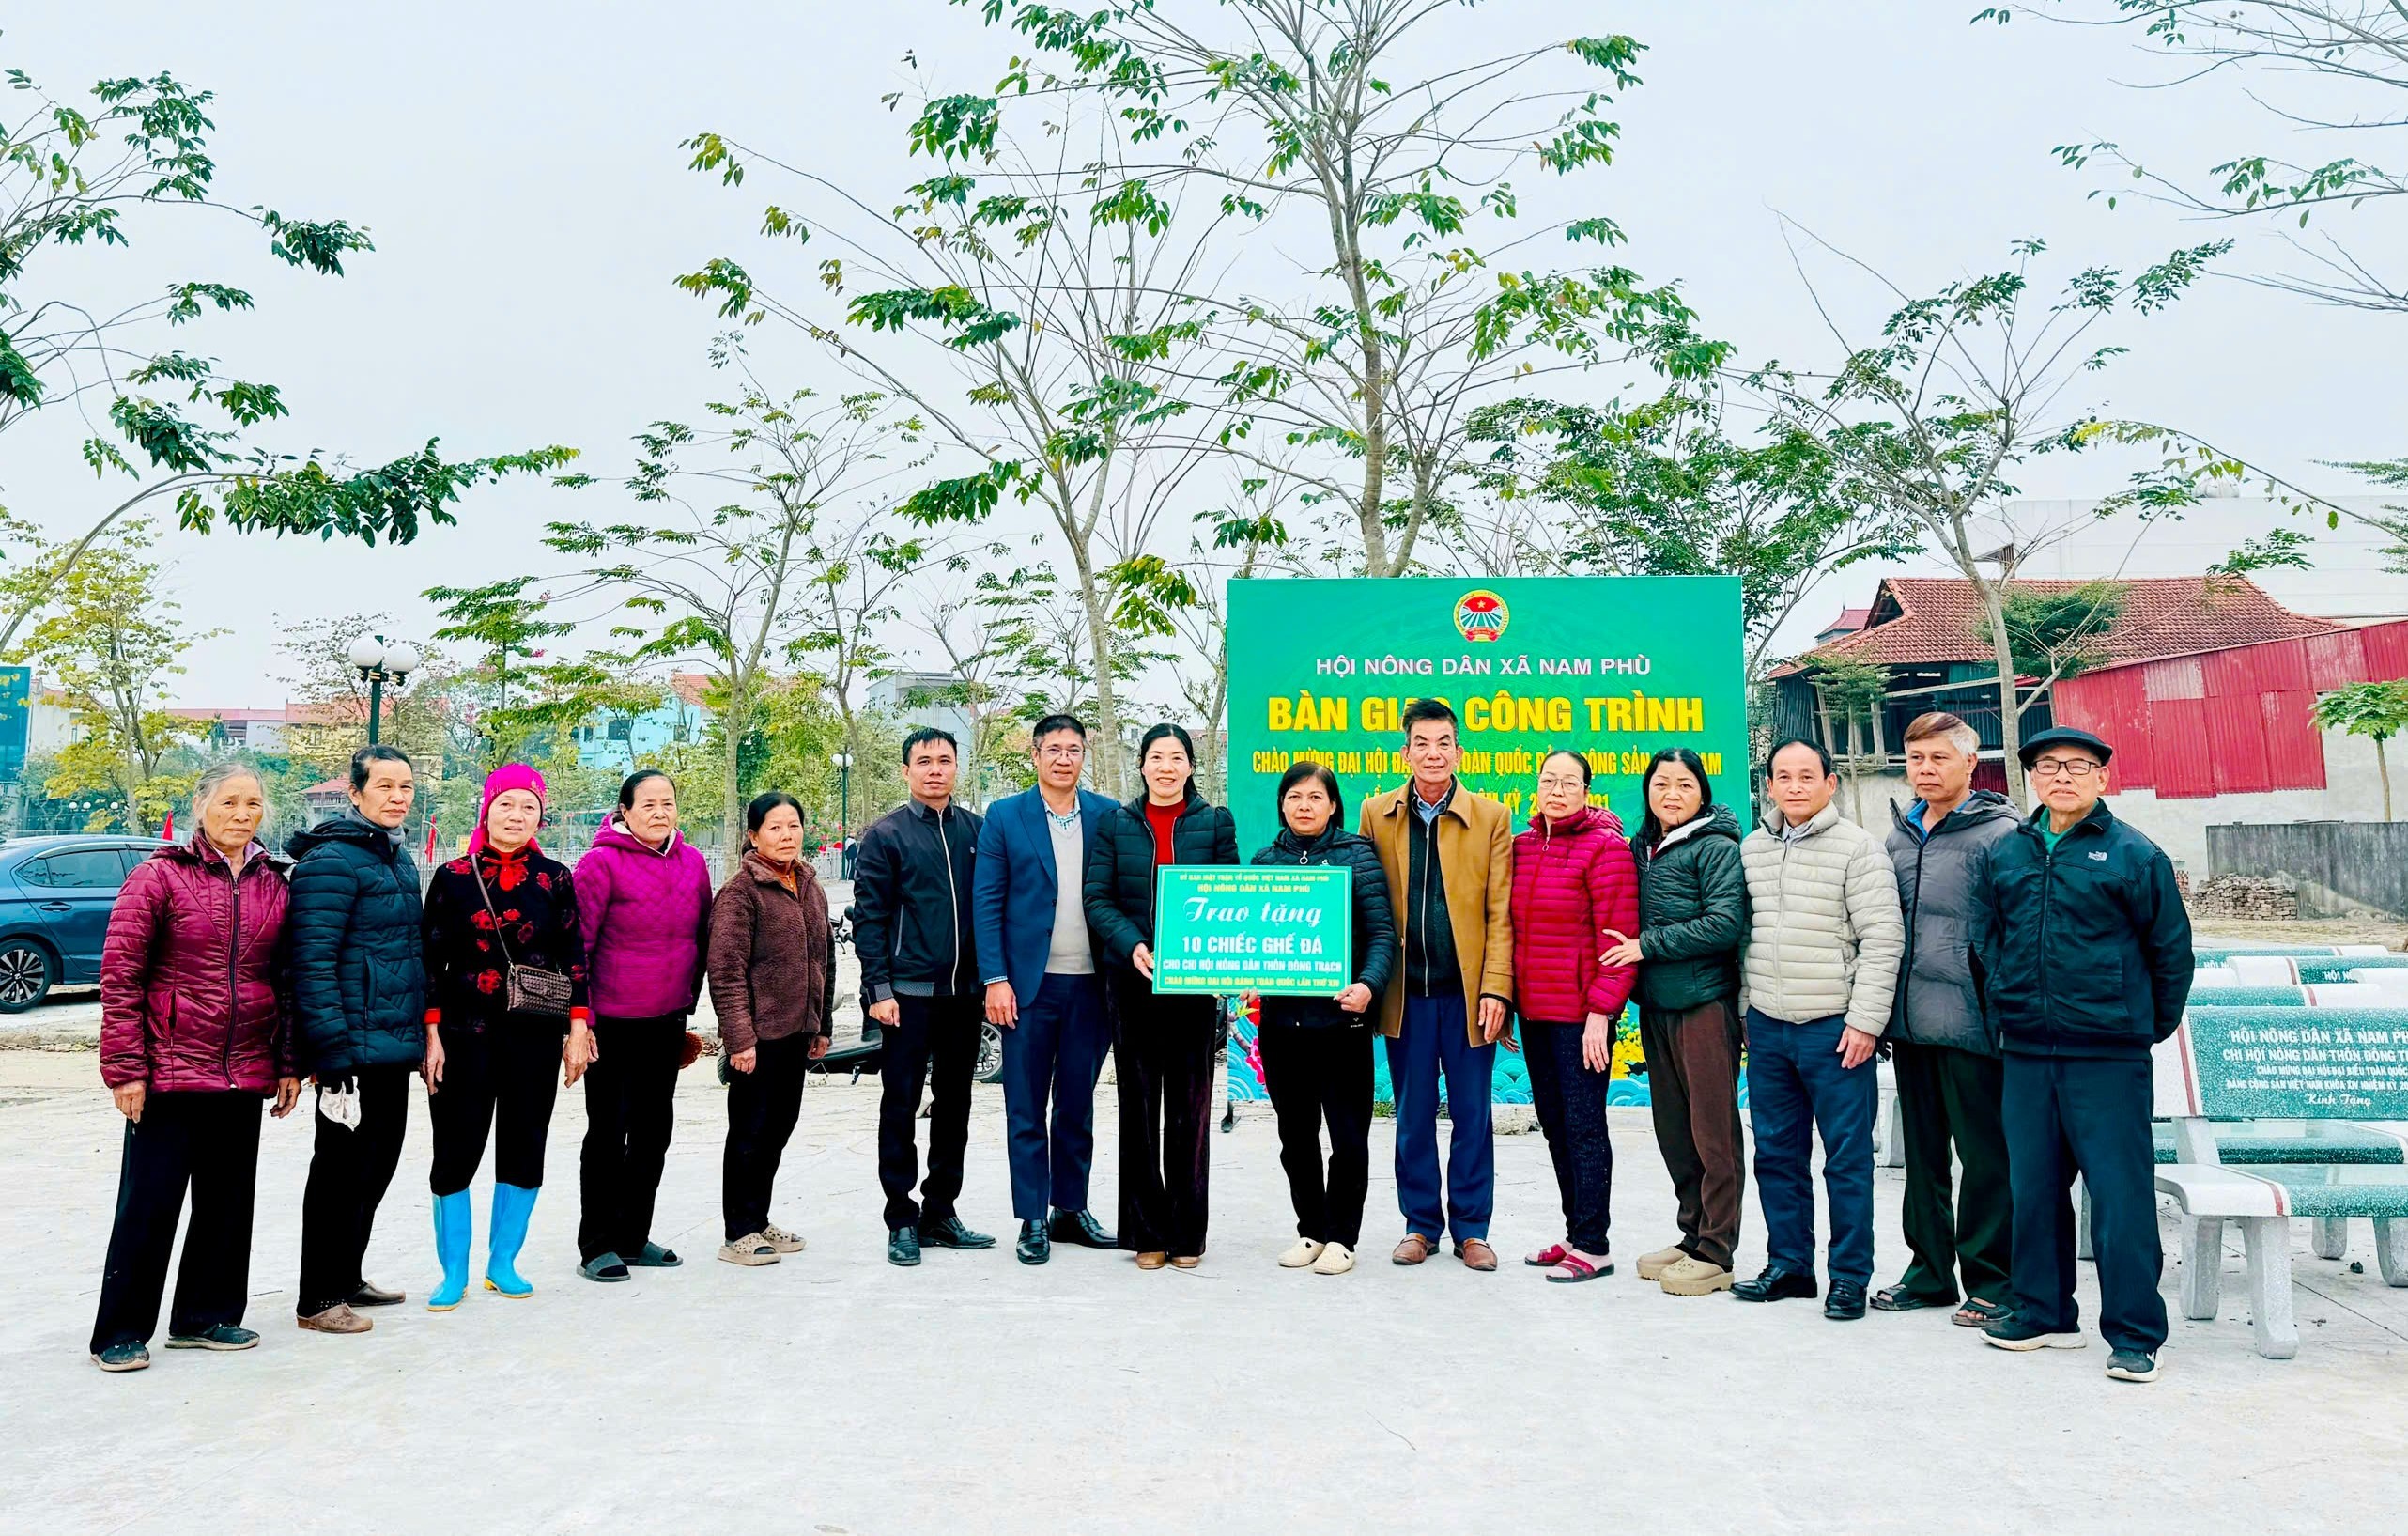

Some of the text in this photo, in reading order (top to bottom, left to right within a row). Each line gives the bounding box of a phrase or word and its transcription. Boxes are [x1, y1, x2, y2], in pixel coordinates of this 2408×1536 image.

[1316, 654, 1651, 678] HỘI NÔNG DÂN XÃ NAM PHÙ
[1268, 690, 1348, 731] BÀN
[1465, 690, 1572, 732] CÔNG
[1584, 690, 1704, 732] TRÌNH
[1253, 745, 1289, 774] CHÀO
[1337, 752, 1361, 779] ĐẠI
[1365, 746, 1388, 779] HỘI
[1495, 744, 1532, 777] QUỐC
[1272, 884, 1291, 892] NAM
[1183, 897, 1322, 928] Trao tặng
[1182, 931, 1323, 954] 10 CHIẾC GHẾ ĐÁ
[1163, 959, 1180, 970] CHO
[1182, 959, 1196, 970] CHI
[1199, 958, 1213, 972] HỘI
[1216, 958, 1240, 970] NÔNG
[1243, 958, 1260, 970] DÂN
[1263, 958, 1286, 971] THÔN
[1314, 960, 1342, 973] TRẠCH
[2230, 1027, 2255, 1045] HỘI
[2260, 1027, 2298, 1043] NÔNG
[2301, 1027, 2330, 1043] DÂN
[2334, 1028, 2353, 1044] XÃ
[2357, 1031, 2389, 1044] NAM
[2246, 1047, 2266, 1063] HỘI
[2268, 1047, 2300, 1061] NÔNG
[2302, 1047, 2326, 1061] DÂN
[2329, 1047, 2361, 1062] THÔN
